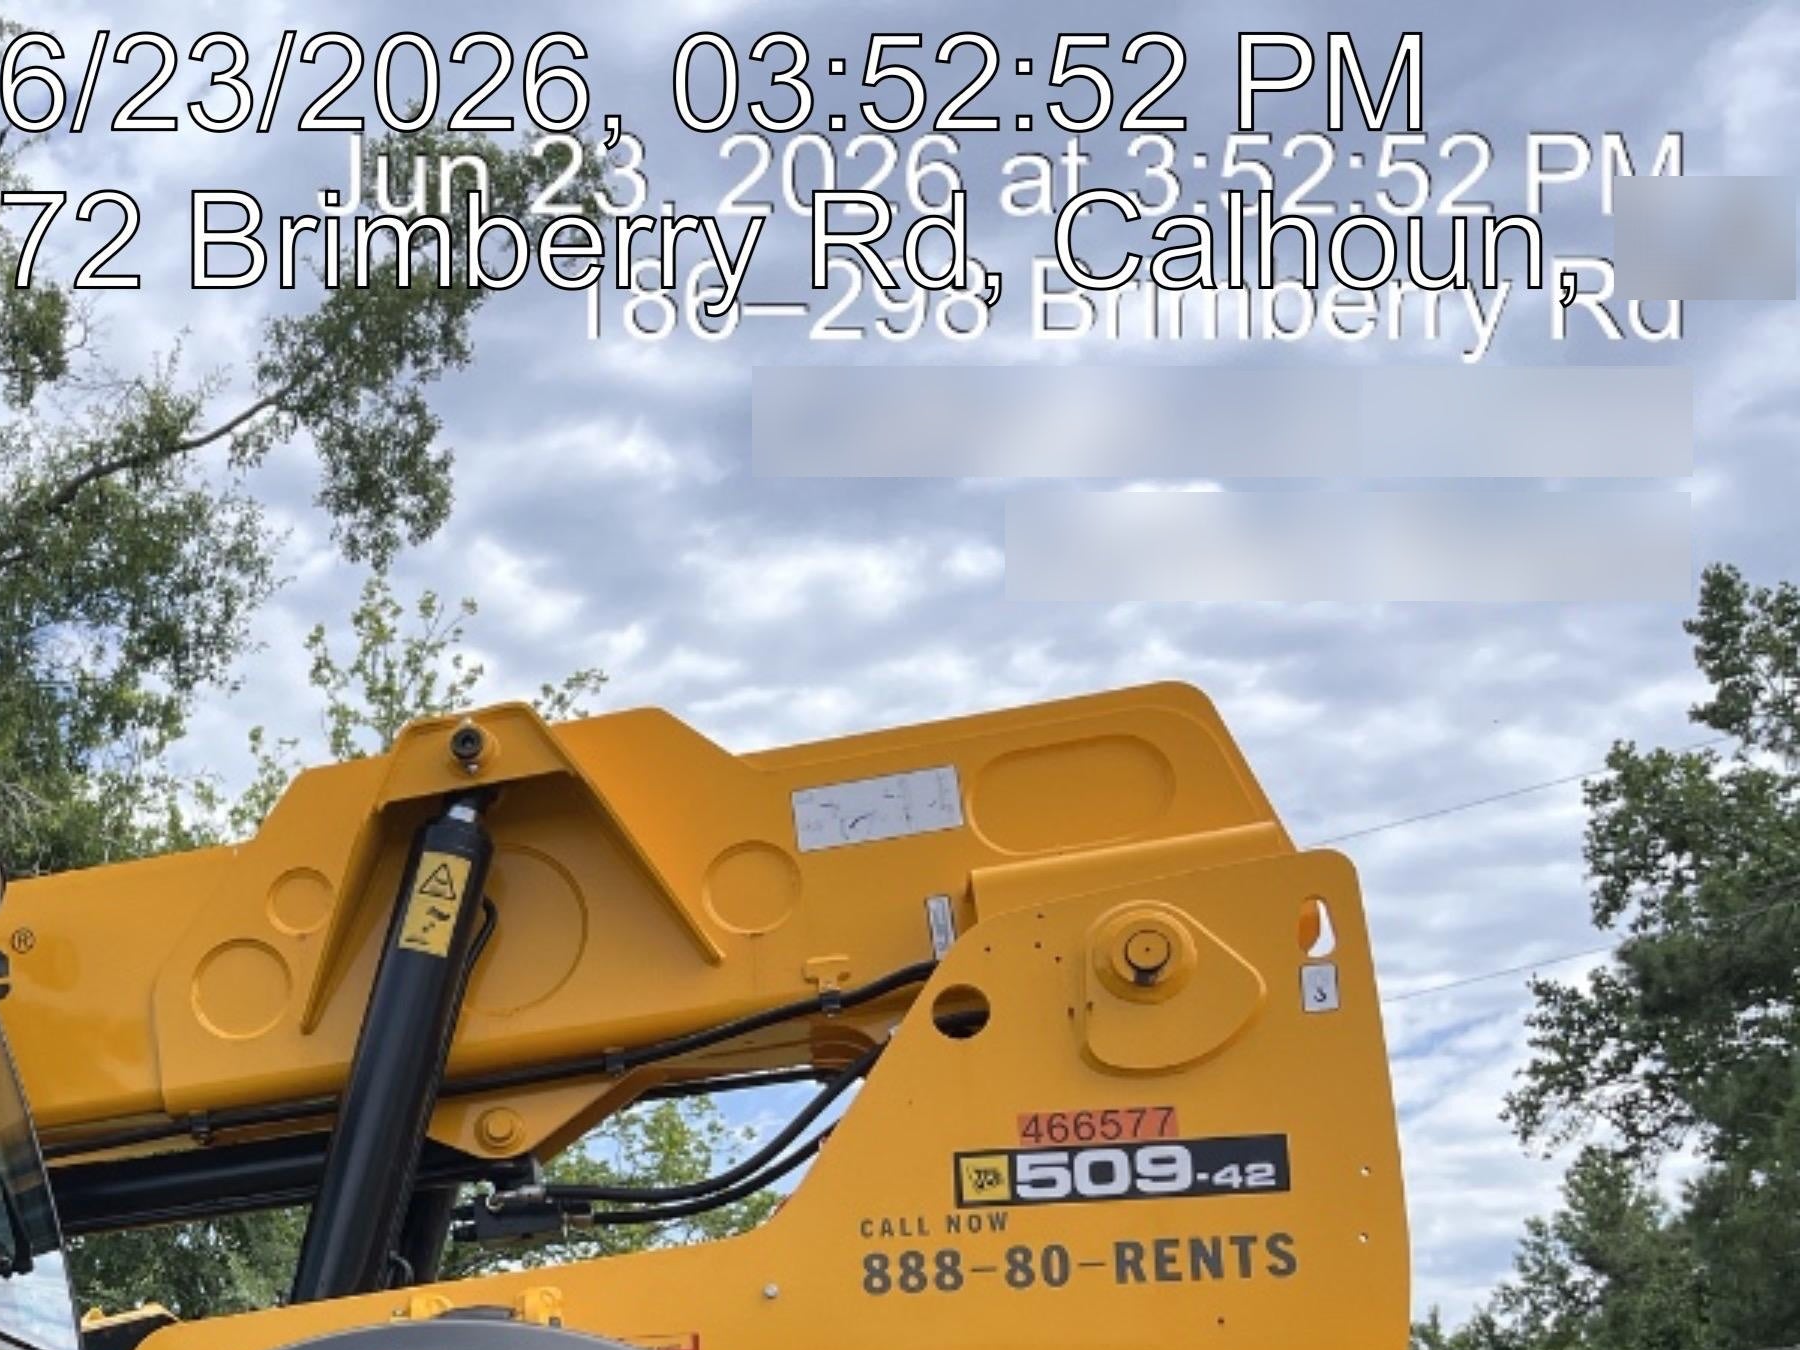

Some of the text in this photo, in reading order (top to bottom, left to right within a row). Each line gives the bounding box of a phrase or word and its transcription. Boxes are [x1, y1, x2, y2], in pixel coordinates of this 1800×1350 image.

[1020, 1106, 1175, 1144] 466577
[1015, 1145, 1277, 1199] 509-42
[860, 1202, 1009, 1238] CALL NOW
[862, 1232, 1298, 1295] 888-80-RENTS
